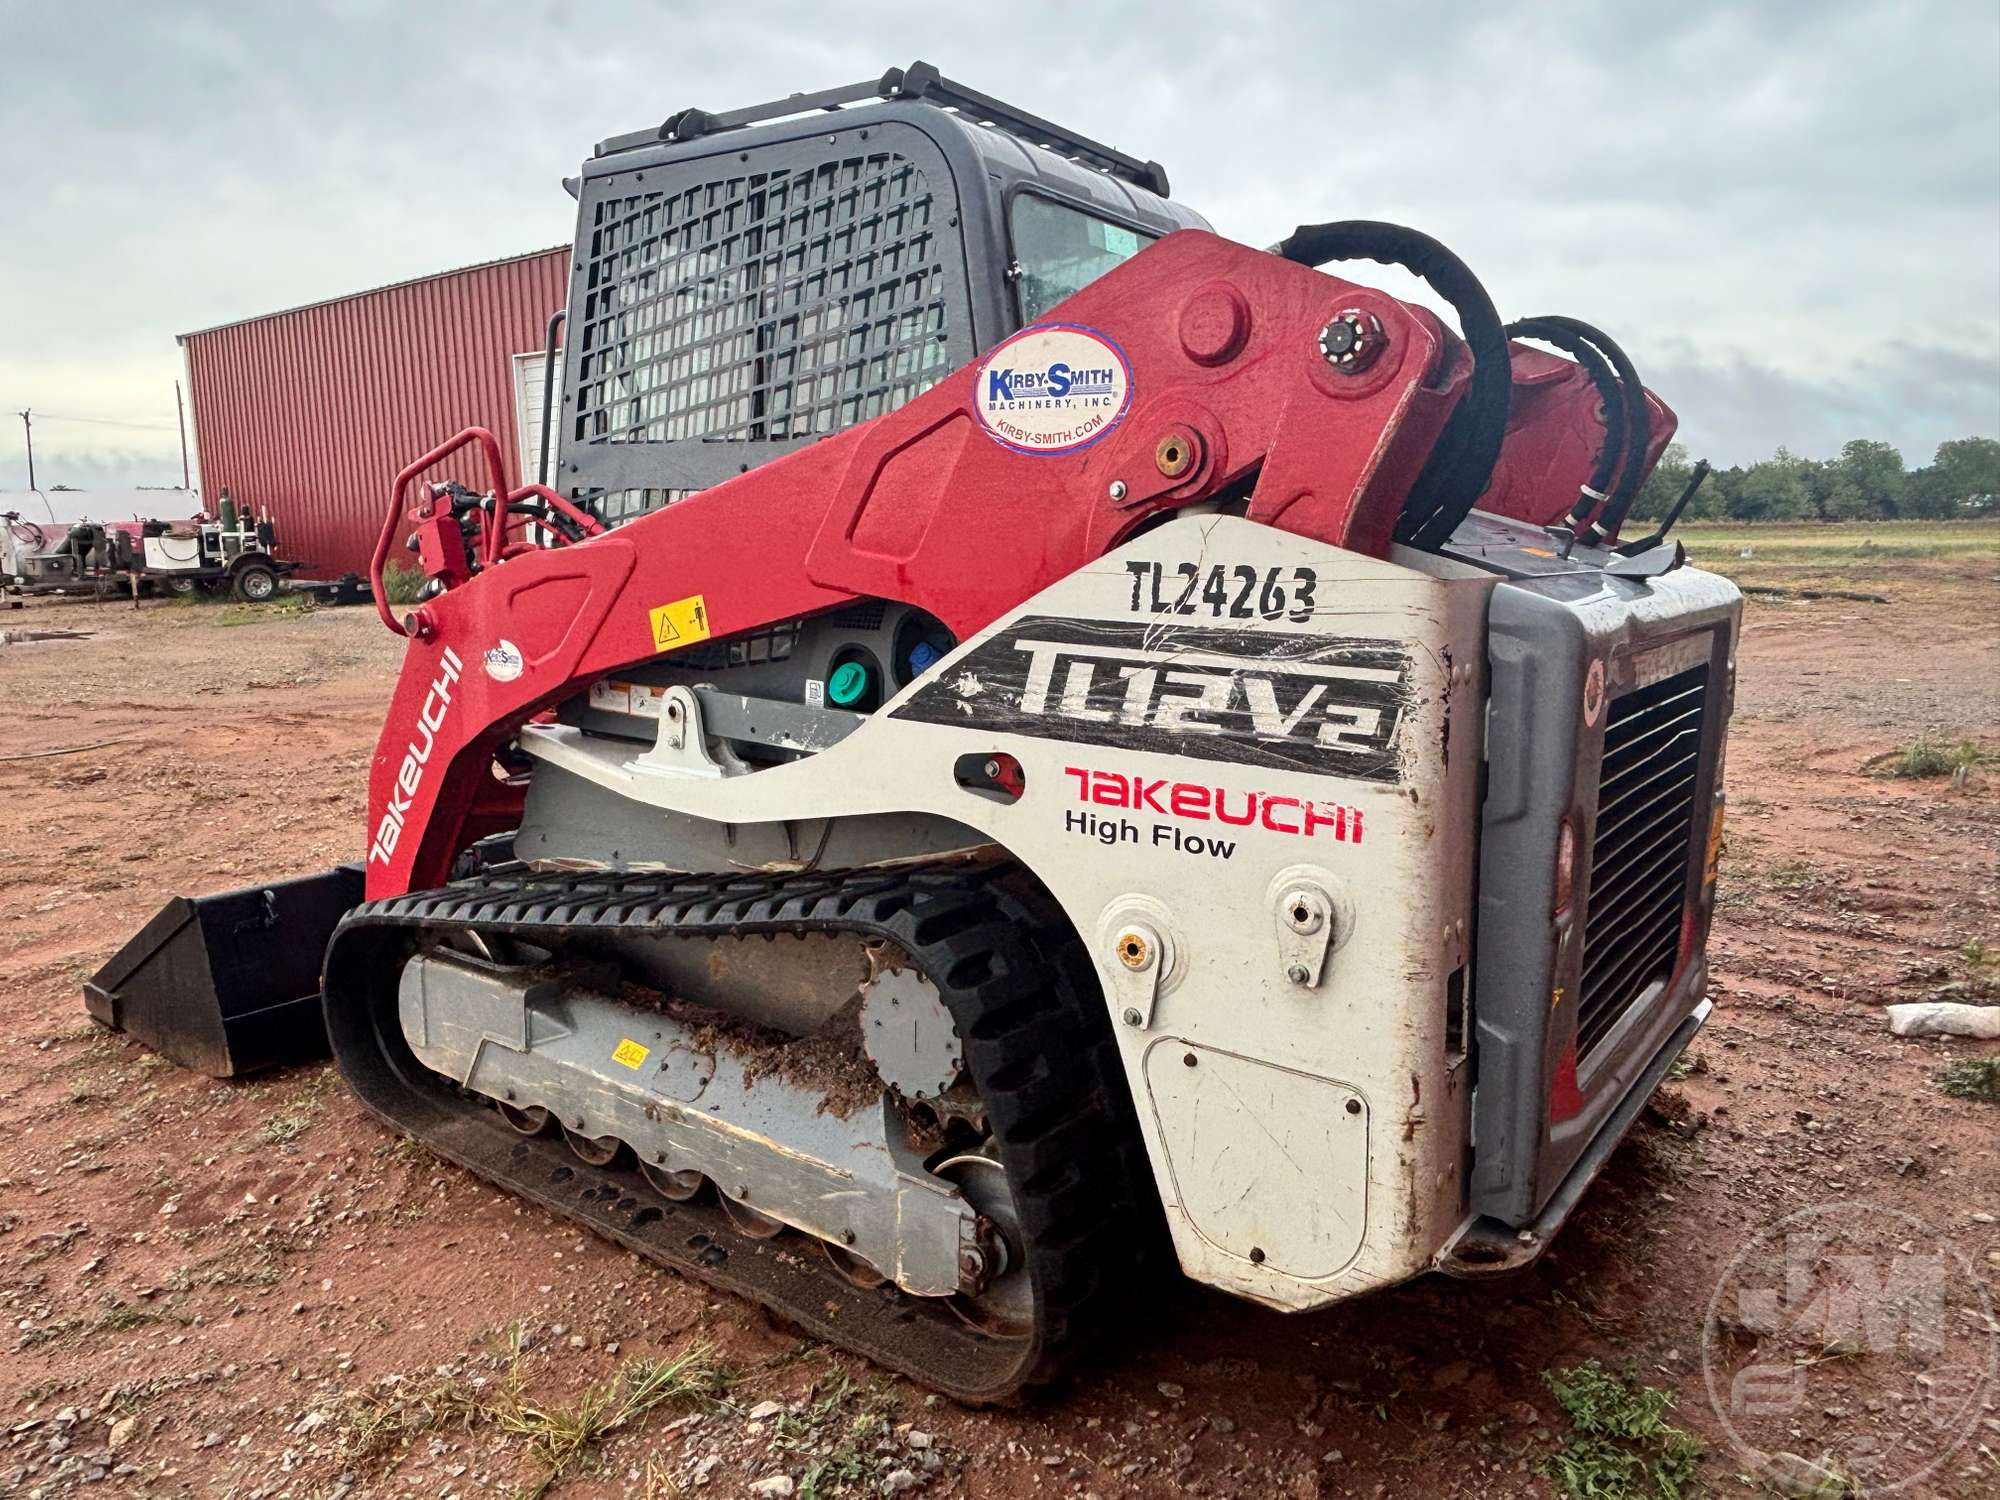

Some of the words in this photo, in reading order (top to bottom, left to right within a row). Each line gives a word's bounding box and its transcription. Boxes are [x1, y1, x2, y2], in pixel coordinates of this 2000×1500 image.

[996, 414, 1104, 445] KIRBY-SMITH.COM
[1126, 561, 1317, 623] TL24263
[369, 645, 464, 866] TAKEUCHI
[1064, 766, 1365, 844] TAKEUCHI
[1065, 810, 1139, 846] High
[1152, 824, 1236, 860] Flow
